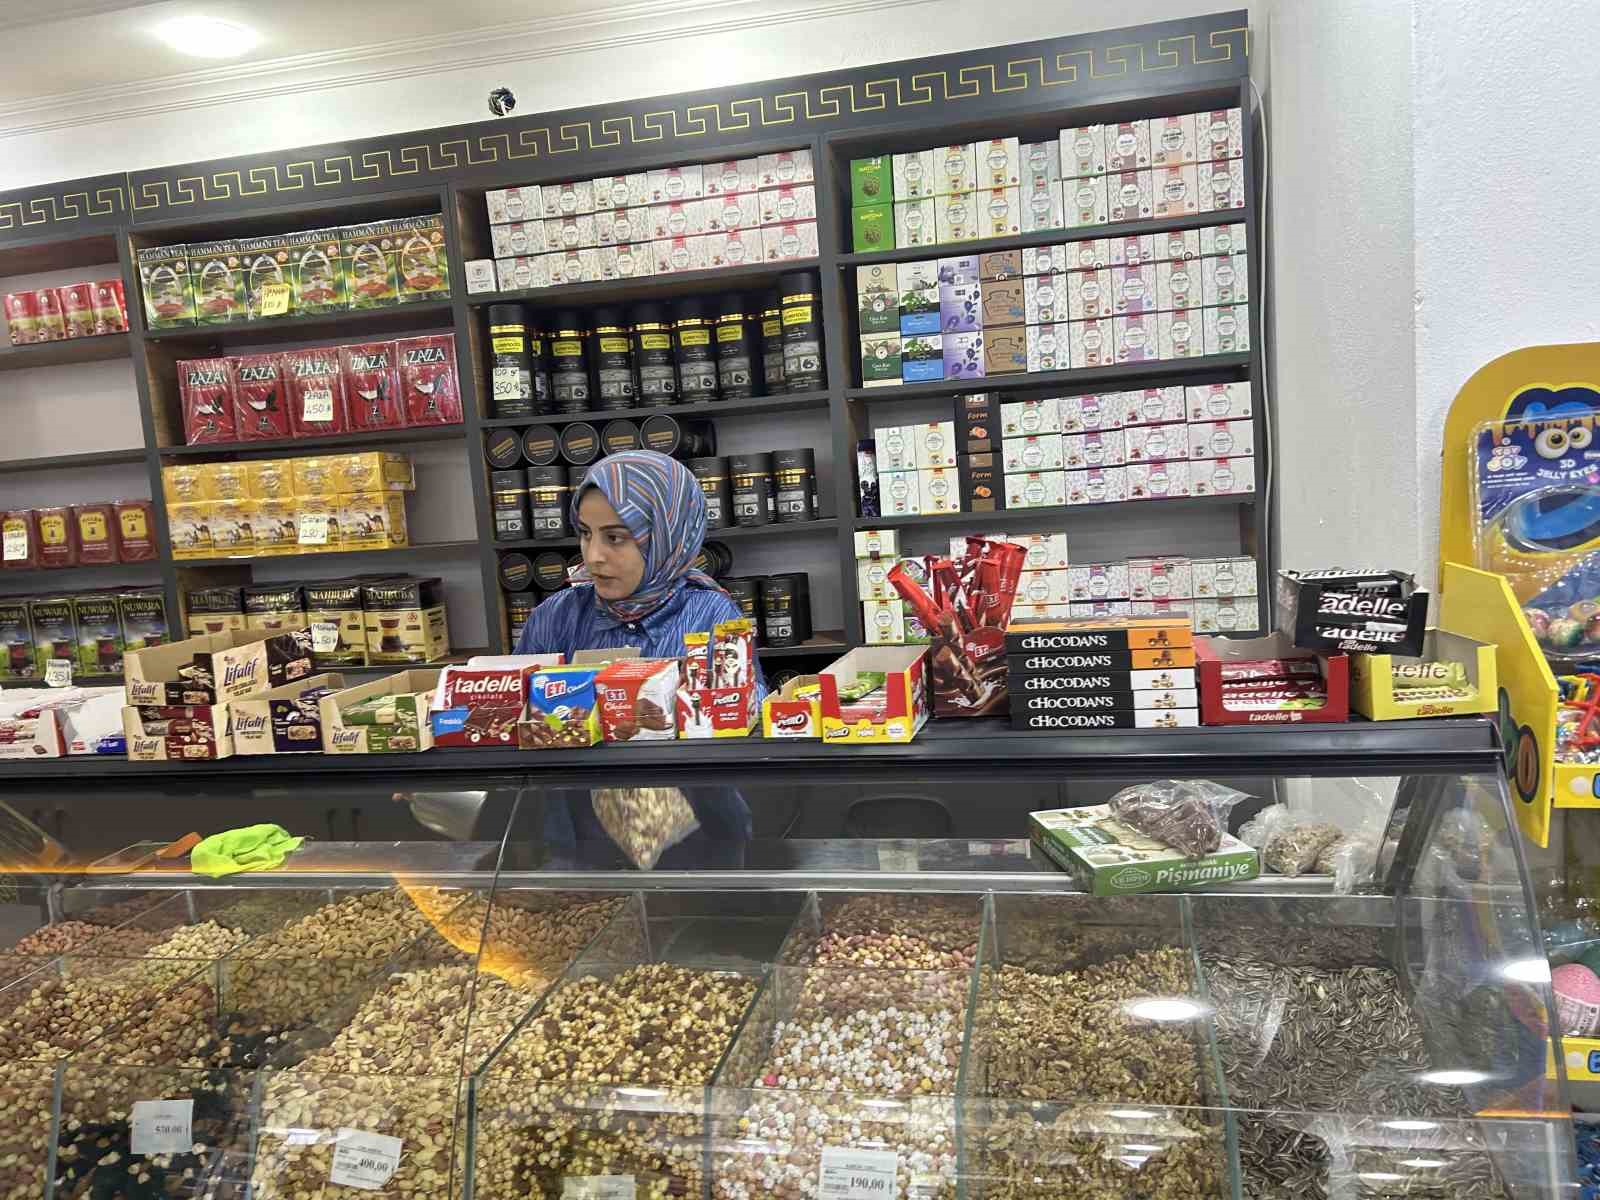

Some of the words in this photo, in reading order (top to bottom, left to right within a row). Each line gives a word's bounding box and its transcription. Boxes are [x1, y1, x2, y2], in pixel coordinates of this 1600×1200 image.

[352, 355, 387, 370] ZAZA
[408, 348, 445, 363] ZAZA
[241, 367, 277, 379] ZAZA
[296, 360, 331, 376] ZAZA
[189, 370, 224, 385] ZAZA
[1559, 459, 1576, 468] 3D
[1536, 469, 1568, 480] JELLY
[455, 675, 521, 693] tadelle
[1156, 862, 1249, 886] Pişmaniye
